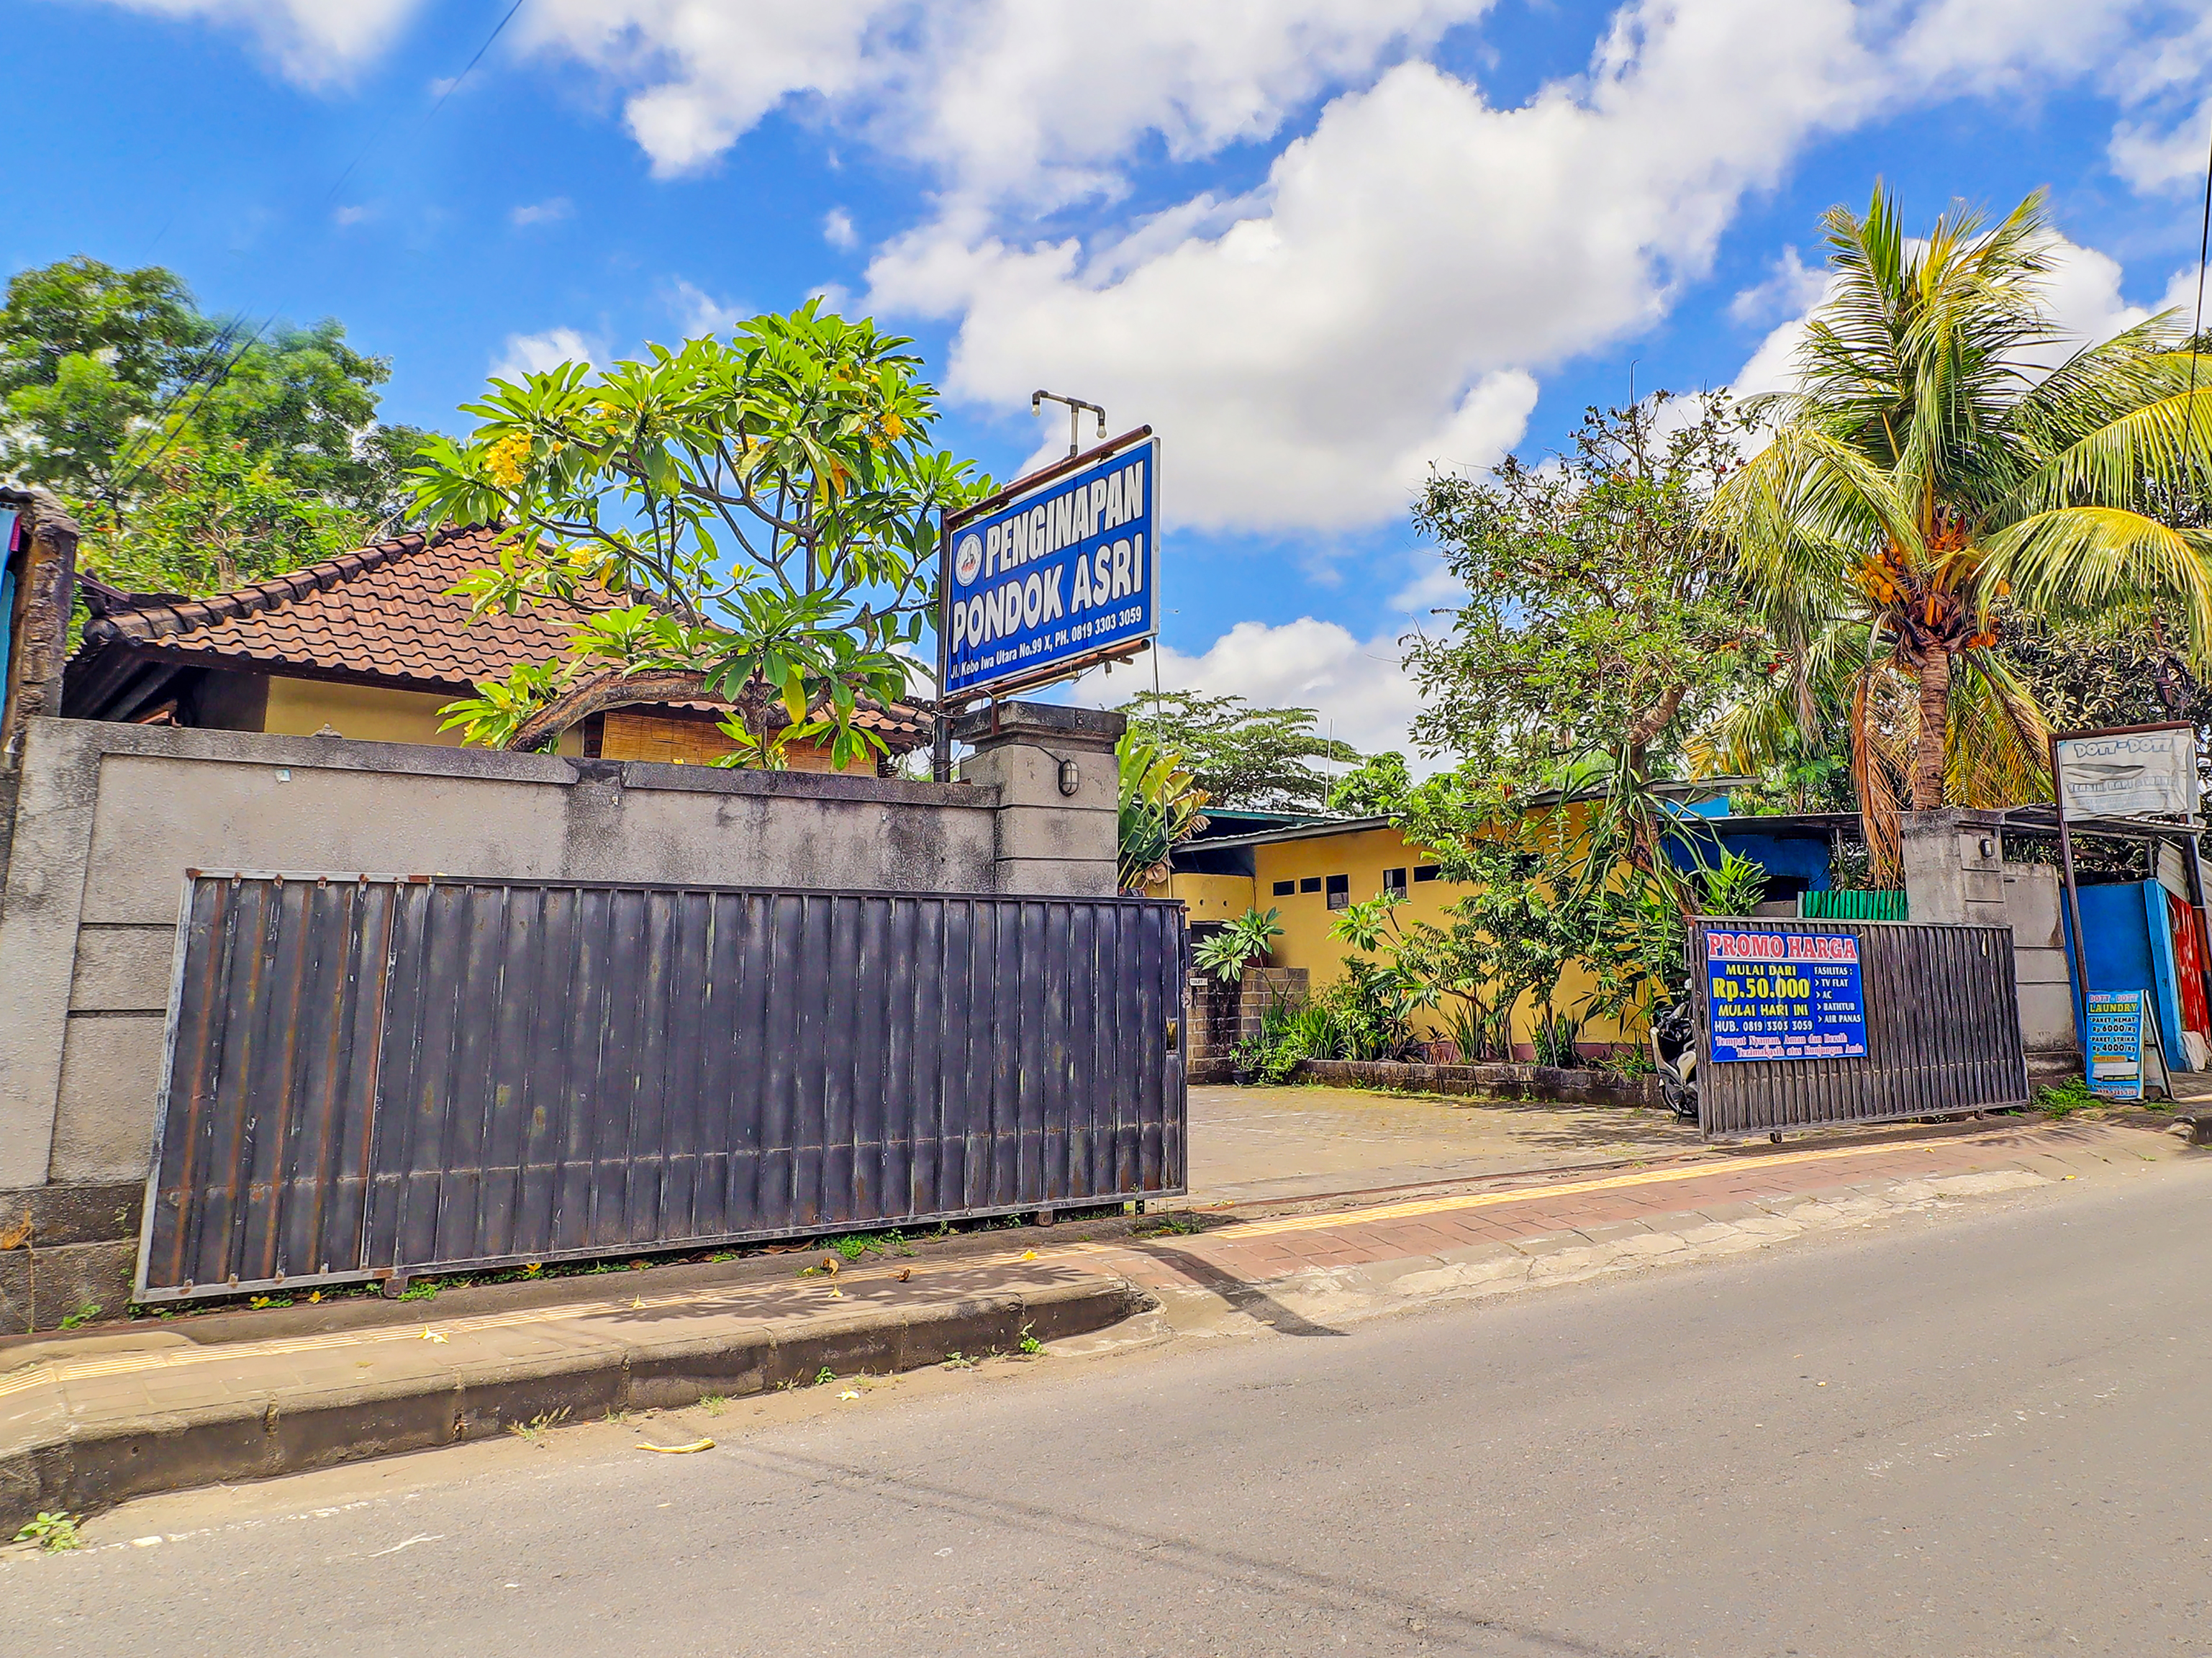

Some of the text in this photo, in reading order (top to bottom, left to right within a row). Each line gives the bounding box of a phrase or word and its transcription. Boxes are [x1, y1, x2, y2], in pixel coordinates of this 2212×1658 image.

[985, 461, 1144, 578] PENGINAPAN
[952, 563, 1064, 654] PONDOK
[1071, 533, 1143, 614] ASRI
[951, 664, 959, 679] Jl.
[961, 659, 979, 677] Kebo
[981, 656, 994, 671] Iwa
[996, 649, 1017, 666] Utara
[1019, 637, 1042, 658] No.99
[1054, 629, 1069, 648] PH.
[1071, 621, 1092, 642] 0819
[1094, 613, 1116, 635] 3303
[1118, 605, 1142, 628] 3059
[1707, 933, 1857, 959] PROMO HARGA
[1726, 964, 1797, 977] MULAI DARI
[1821, 979, 1849, 987] TV FLAT
[1712, 977, 1810, 1002] Rp.50.000
[1822, 990, 1833, 999] AC
[2090, 995, 2111, 1003] DOTT
[2116, 994, 2138, 1002] DOTT
[1718, 1005, 1809, 1017] MULAI HARI INI
[1823, 1002, 1855, 1011] BATHTUB
[2090, 1003, 2137, 1013] LAUNDRY
[1824, 1014, 1862, 1023] AIR PANAS
[1714, 1020, 1813, 1032] HUB. 0819 3303 3059
[1715, 1036, 1746, 1048] Tempat
[1784, 1034, 1806, 1043] Aman
[1808, 1033, 1822, 1043] dan
[1823, 1033, 1847, 1042] Bersih
[1786, 1046, 1802, 1056] atas
[1804, 1045, 1843, 1057] Kunjungan
[1845, 1043, 1864, 1054] Anda
